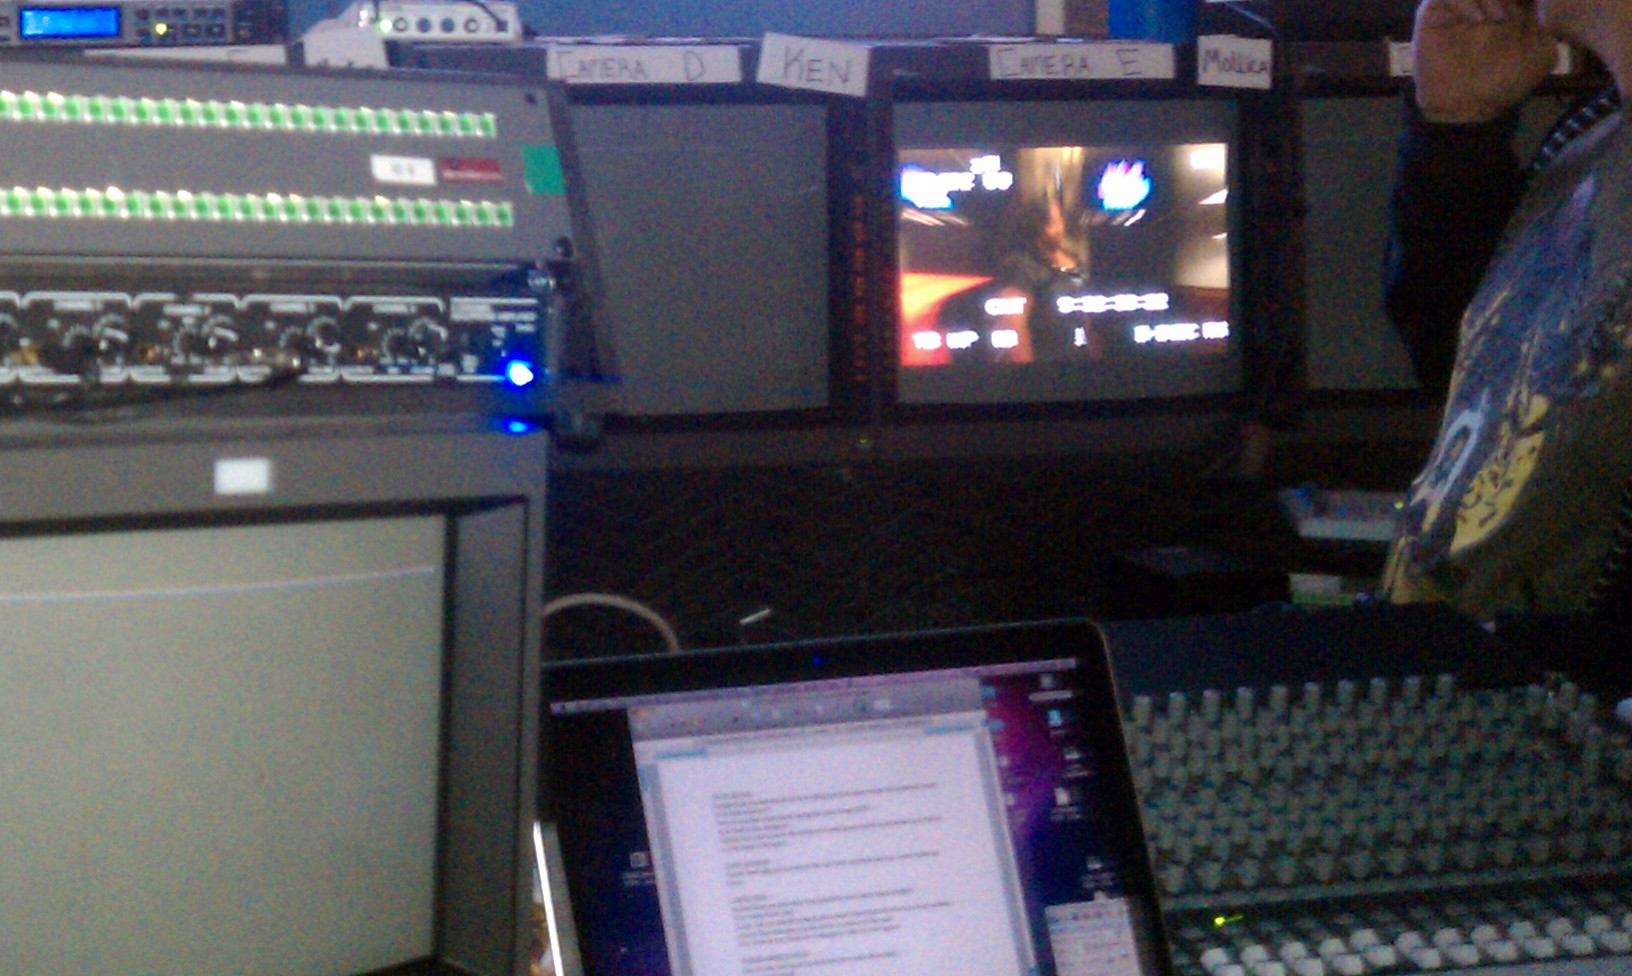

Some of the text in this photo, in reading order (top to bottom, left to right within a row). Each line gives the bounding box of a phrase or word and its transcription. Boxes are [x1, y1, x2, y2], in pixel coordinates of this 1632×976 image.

[555, 50, 707, 81] CAMERA D
[782, 45, 851, 86] KEN
[996, 47, 1142, 77] CAMERA E
